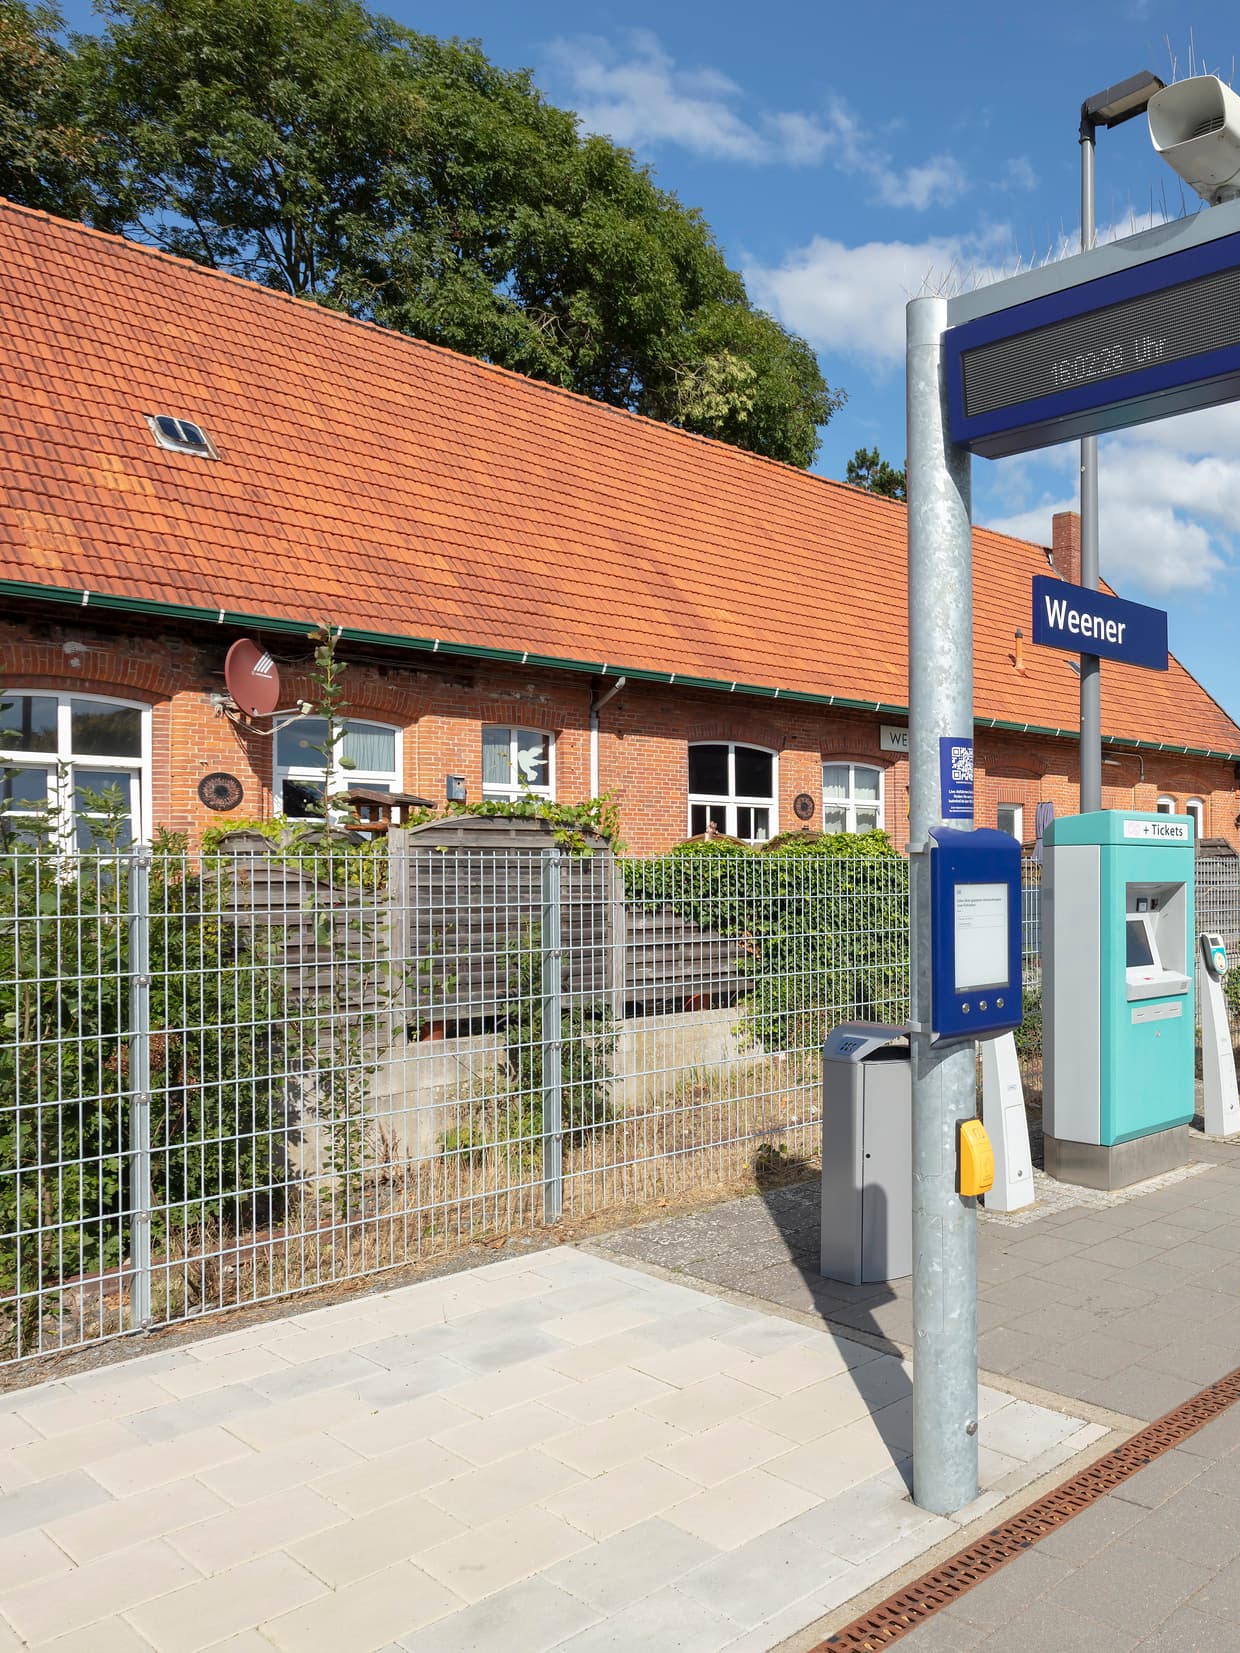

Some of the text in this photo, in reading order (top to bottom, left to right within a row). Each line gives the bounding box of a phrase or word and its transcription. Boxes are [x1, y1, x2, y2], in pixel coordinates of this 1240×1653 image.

[1051, 336, 1166, 385] 16:02:28 Uhr
[1044, 594, 1127, 645] Weener
[1151, 824, 1183, 836] Tickets
